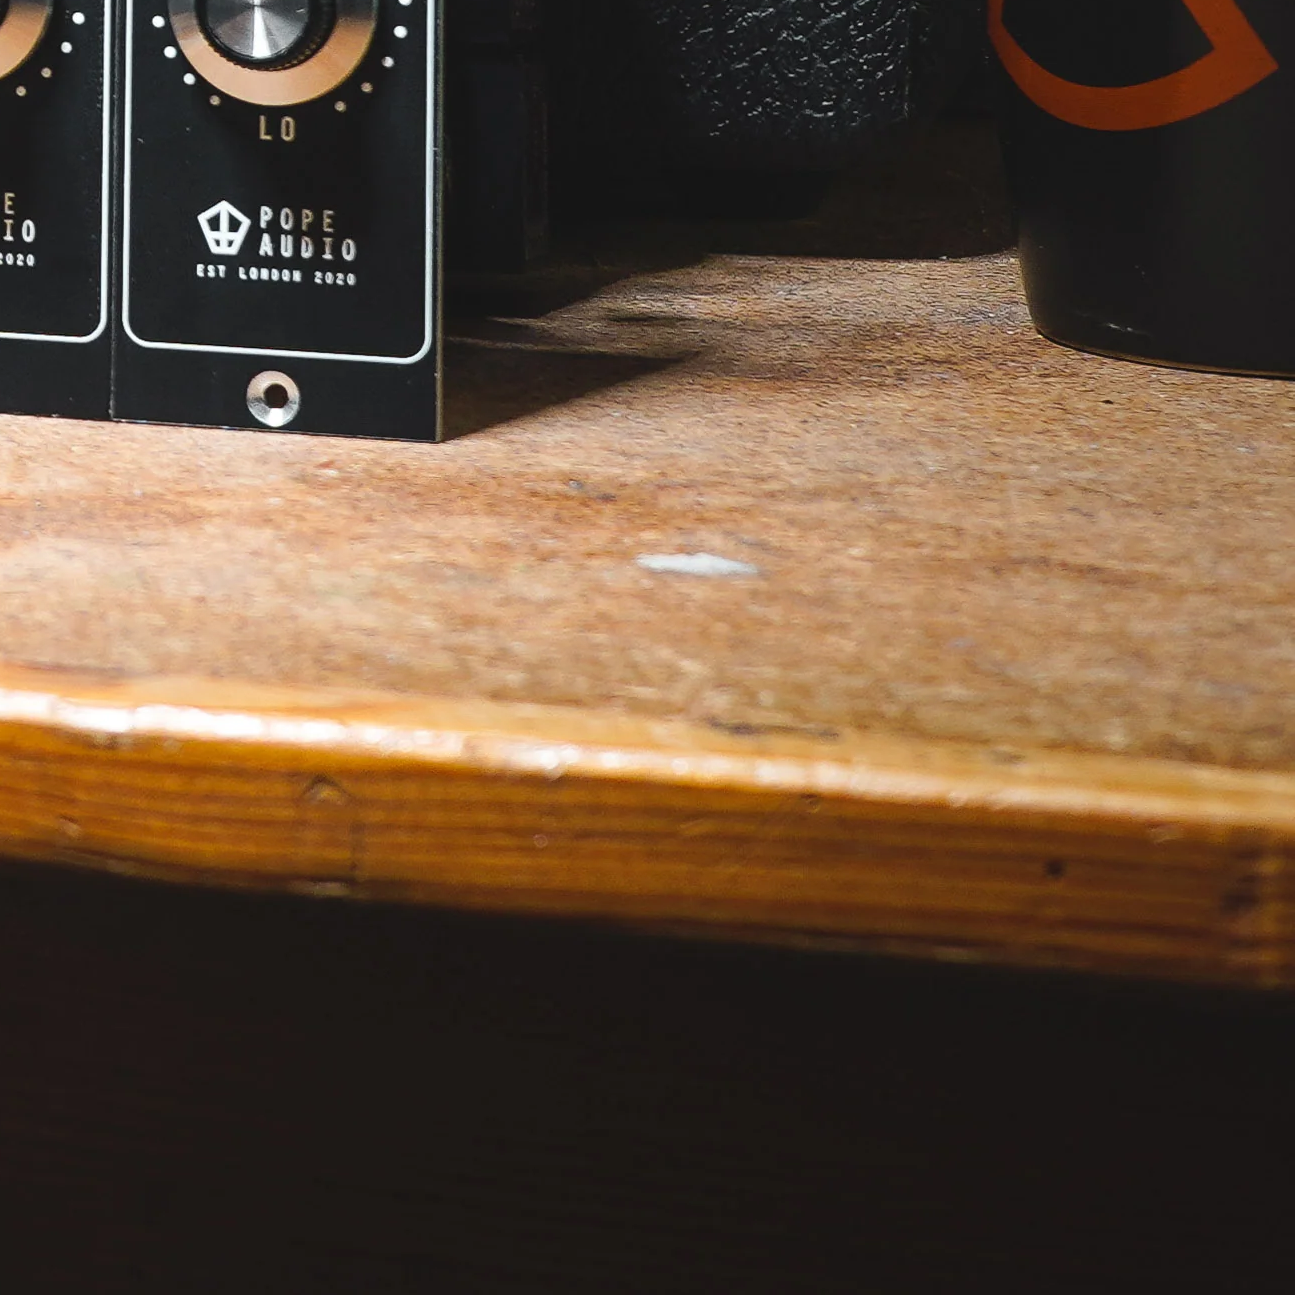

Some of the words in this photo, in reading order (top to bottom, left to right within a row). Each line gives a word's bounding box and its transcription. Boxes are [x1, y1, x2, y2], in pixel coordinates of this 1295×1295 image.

[259, 114, 295, 142] LO
[259, 205, 334, 233] POPE
[258, 232, 357, 262] AUDIO
